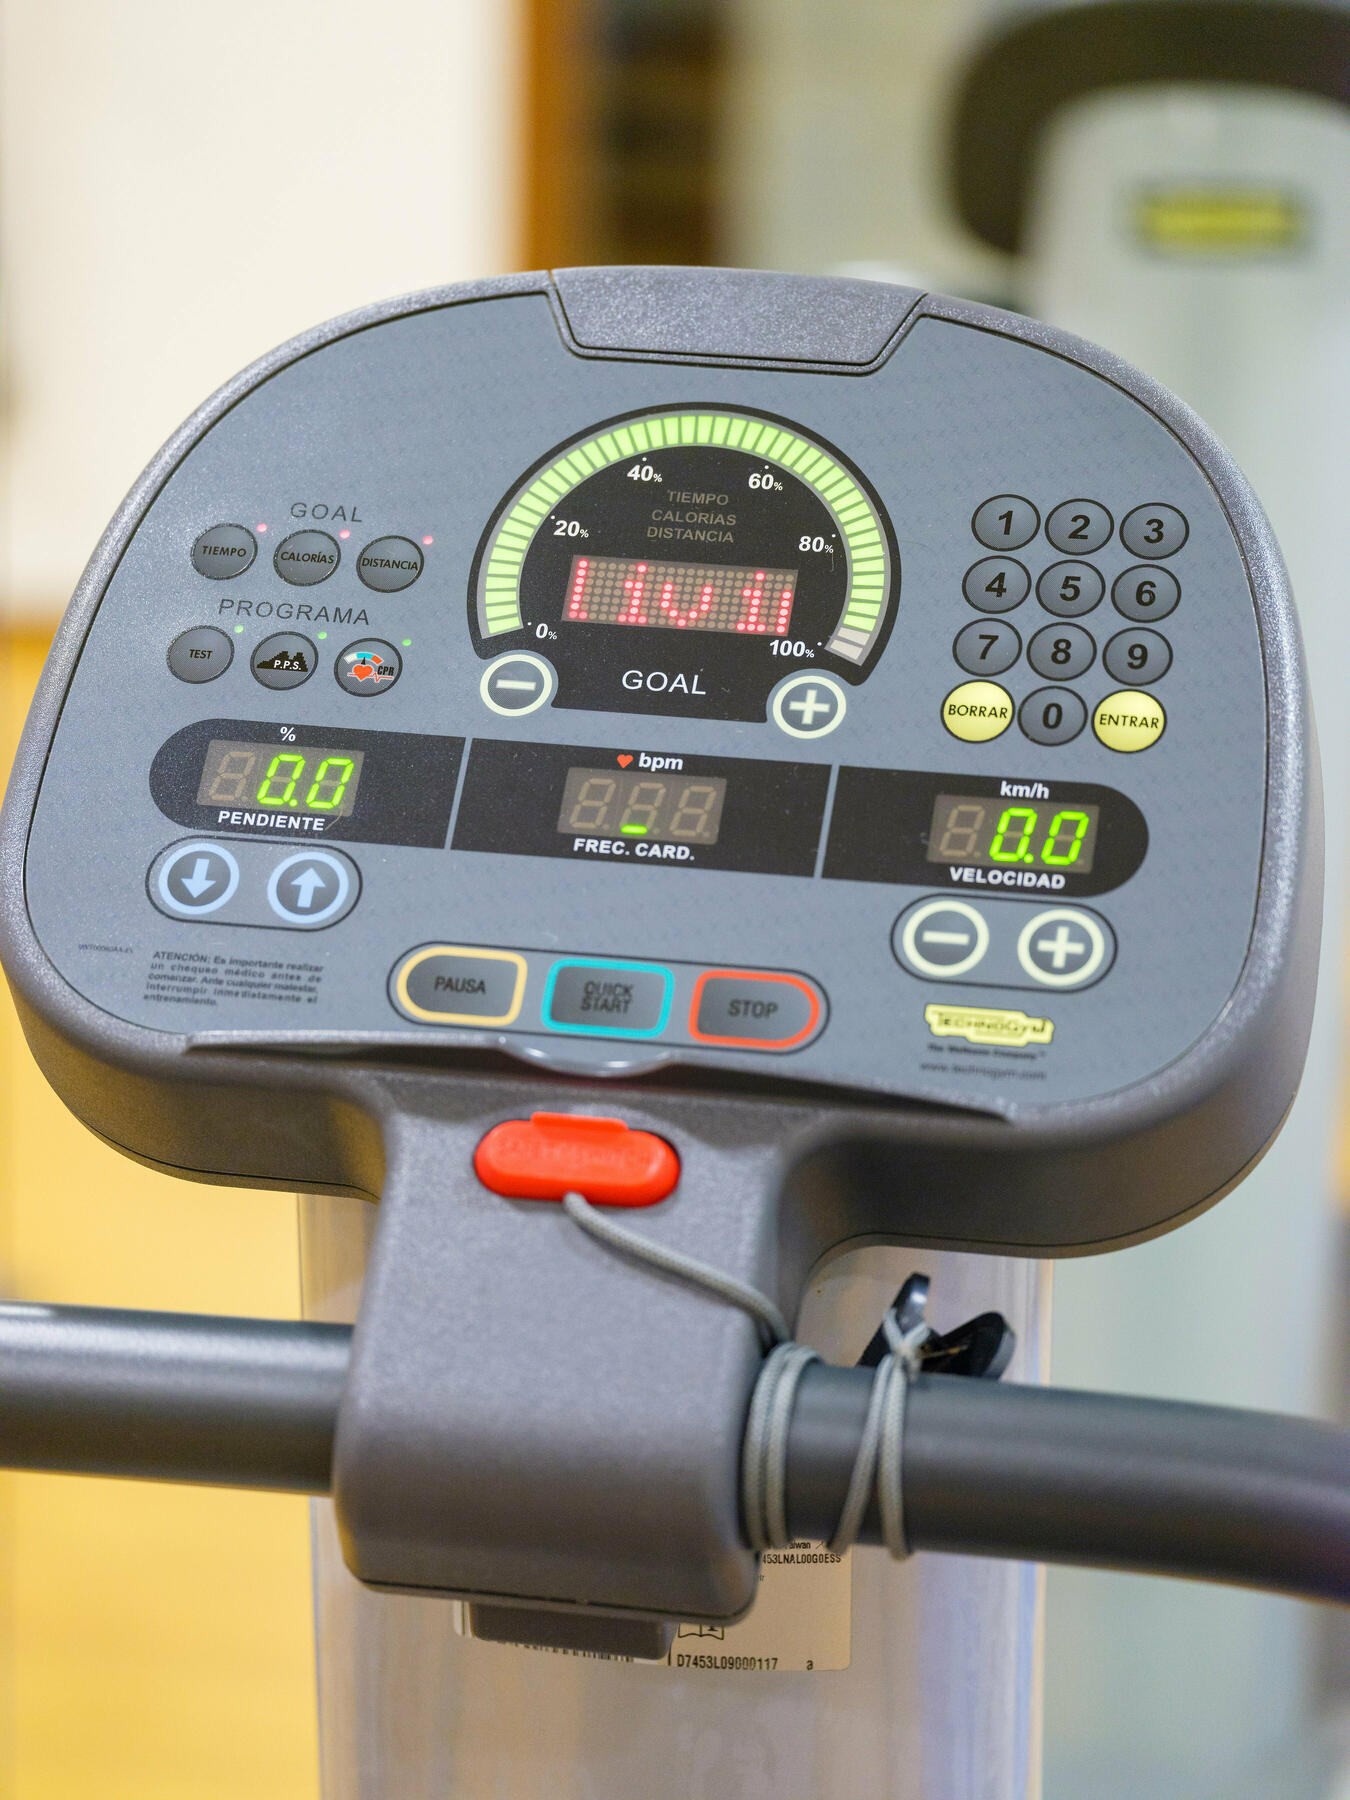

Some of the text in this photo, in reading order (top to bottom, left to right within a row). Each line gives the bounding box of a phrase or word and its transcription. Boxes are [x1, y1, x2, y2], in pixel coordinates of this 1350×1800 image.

[627, 465, 663, 483] 40%
[748, 473, 783, 492] 60%
[667, 490, 729, 506] TIEMPO
[290, 502, 362, 522] GOAL
[553, 520, 590, 538] 20%
[646, 527, 734, 544] DISTANCIA
[998, 510, 1164, 544] 1 2 3
[202, 546, 247, 557] TIEMPO
[798, 536, 834, 554] 80%
[280, 551, 335, 564] CALORÍAS
[361, 557, 419, 571] DISTANCIA
[985, 572, 1156, 606] 4 5 6
[218, 599, 370, 625] PROGRAMA
[535, 623, 558, 641] 0%
[189, 649, 213, 660] TEST
[769, 640, 815, 659] 100%
[978, 634, 1148, 669] 7 8 9
[273, 659, 302, 671] P.P.S.
[377, 665, 395, 677] CPR
[621, 670, 707, 695] GOAL
[948, 704, 1008, 719] BORRAR
[1042, 703, 1063, 729] 0
[1099, 713, 1159, 729] ENTRAR
[280, 726, 296, 742] %
[638, 752, 684, 772] bpm
[1000, 780, 1050, 800] km/h
[218, 810, 326, 831] PENDIENTE
[573, 838, 695, 861] FREC. CARD.
[950, 866, 1066, 890] VELOCIDAD
[434, 976, 486, 995] PAUSA
[583, 981, 635, 999] QUICK
[579, 997, 631, 1016] START
[727, 1000, 778, 1019] STOP
